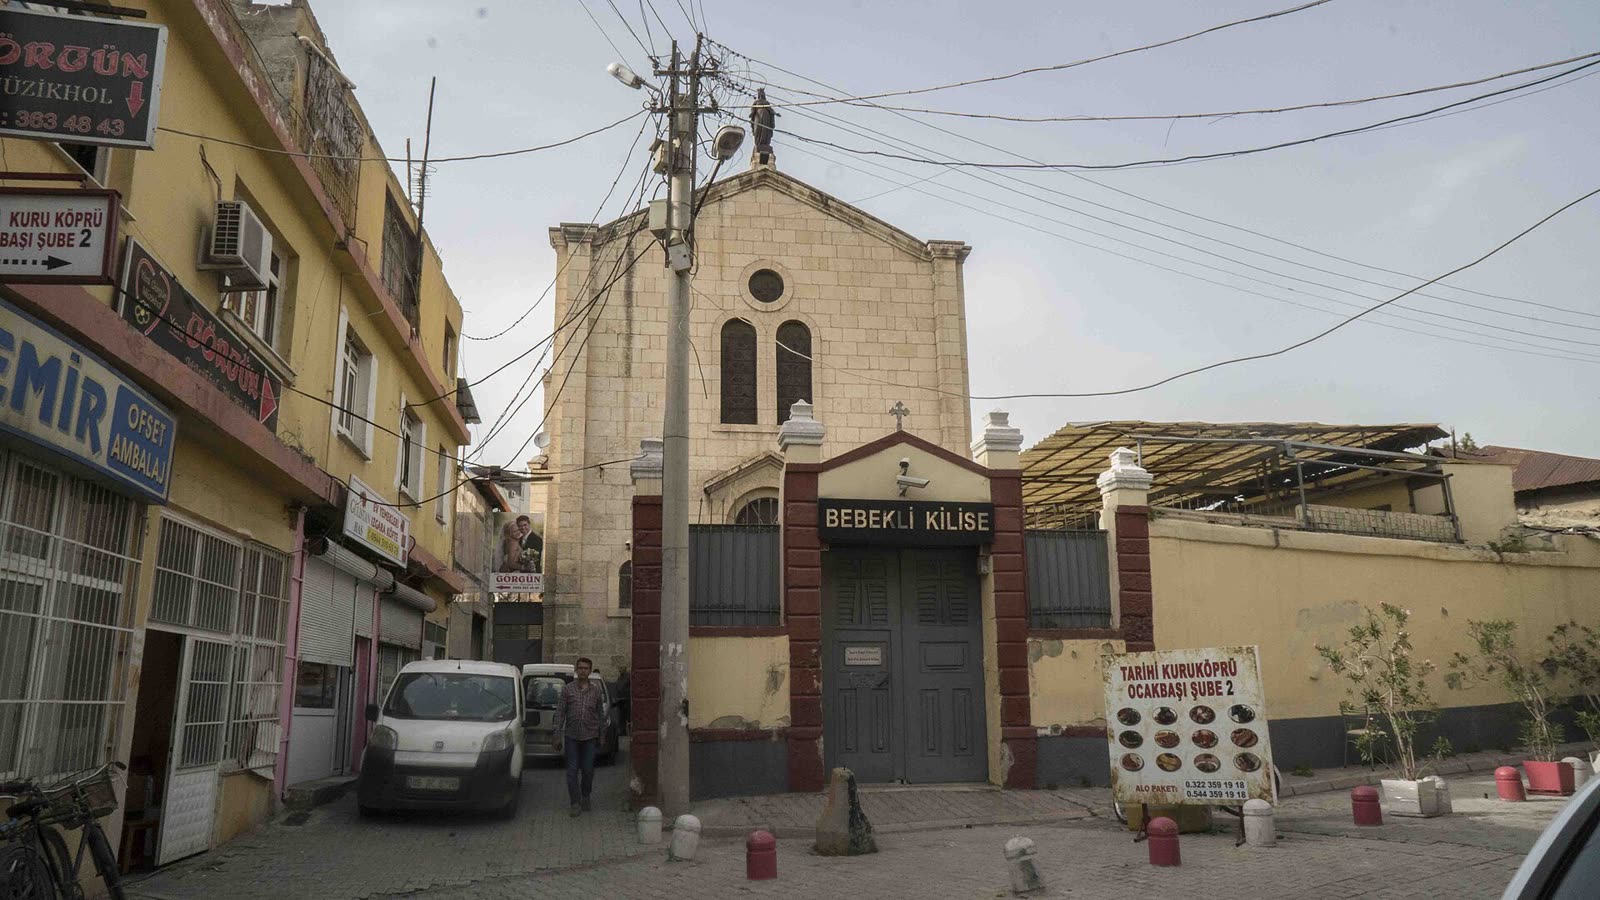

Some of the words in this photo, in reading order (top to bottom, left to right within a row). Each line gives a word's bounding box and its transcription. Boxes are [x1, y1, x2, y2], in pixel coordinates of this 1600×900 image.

[0, 75, 113, 105] ÜZİKHOL
[16, 110, 58, 130] 363
[62, 114, 92, 133] 48
[96, 117, 125, 136] 43
[9, 211, 50, 228] KURU
[55, 208, 103, 228] KÖPRÜ
[0, 232, 33, 251] BAŞI
[37, 232, 76, 252] ŞUBE
[79, 228, 92, 248] 2
[186, 311, 260, 401] GÖRGÜN
[128, 403, 167, 447] OFSET
[110, 432, 167, 485] AMBALAJ
[826, 507, 914, 530] BEBEKLİ
[926, 507, 990, 531] KİLİSE
[1120, 661, 1159, 681] TARİHİ
[1162, 658, 1237, 679] KURUKÖPRÜ
[1128, 682, 1188, 701] OCAKBAŞI
[1190, 681, 1223, 701] ŞUBE
[1226, 680, 1235, 695] 2
[1151, 785, 1178, 793] PAKET:
[1185, 781, 1206, 789] 0.322
[1207, 781, 1222, 789] 359
[1224, 781, 1233, 789] 19
[1236, 781, 1245, 789] 18
[1186, 790, 1207, 798] 0.544
[1208, 790, 1223, 798] 359
[1225, 790, 1234, 798] 19
[1236, 790, 1246, 798] 18
